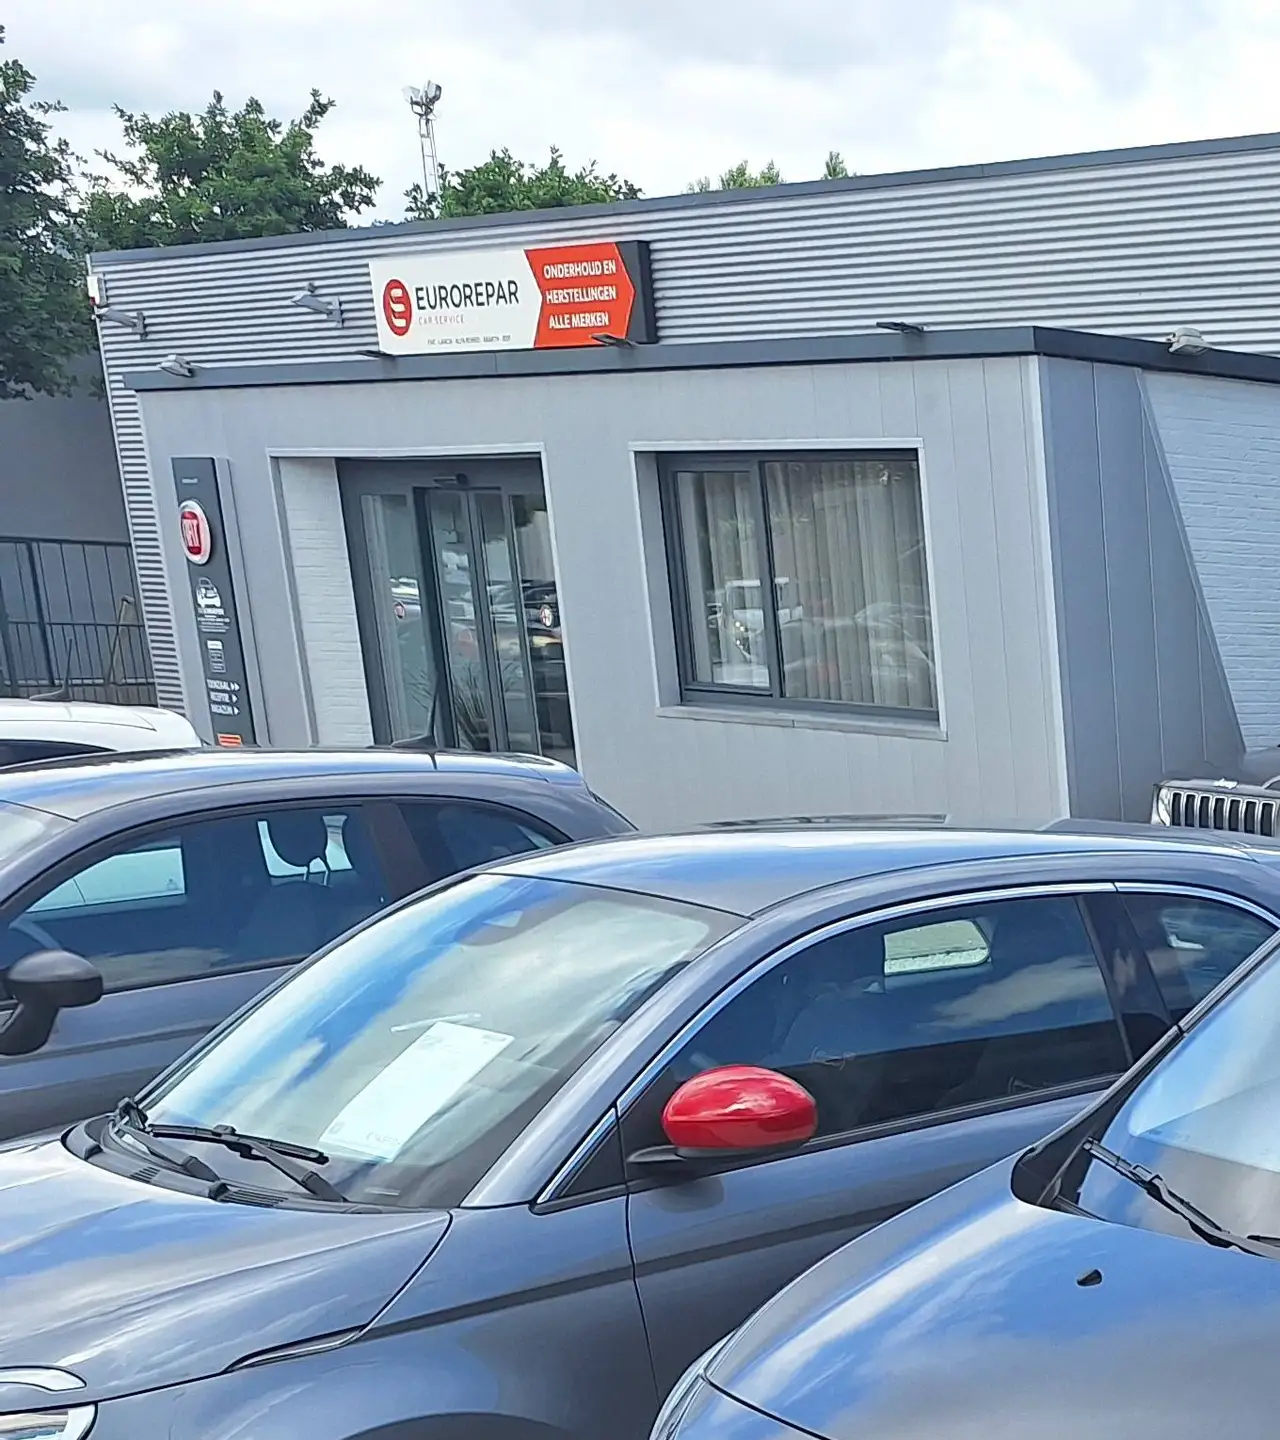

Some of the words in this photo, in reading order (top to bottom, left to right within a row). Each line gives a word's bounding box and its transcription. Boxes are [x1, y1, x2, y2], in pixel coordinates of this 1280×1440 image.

[543, 261, 602, 279] ONDERHOUD
[603, 259, 617, 275] EN
[415, 279, 519, 310] EUROREPAR
[545, 285, 617, 304] HERSTELLINGEN
[549, 313, 571, 329] ALLE
[571, 311, 609, 328] MERKEN
